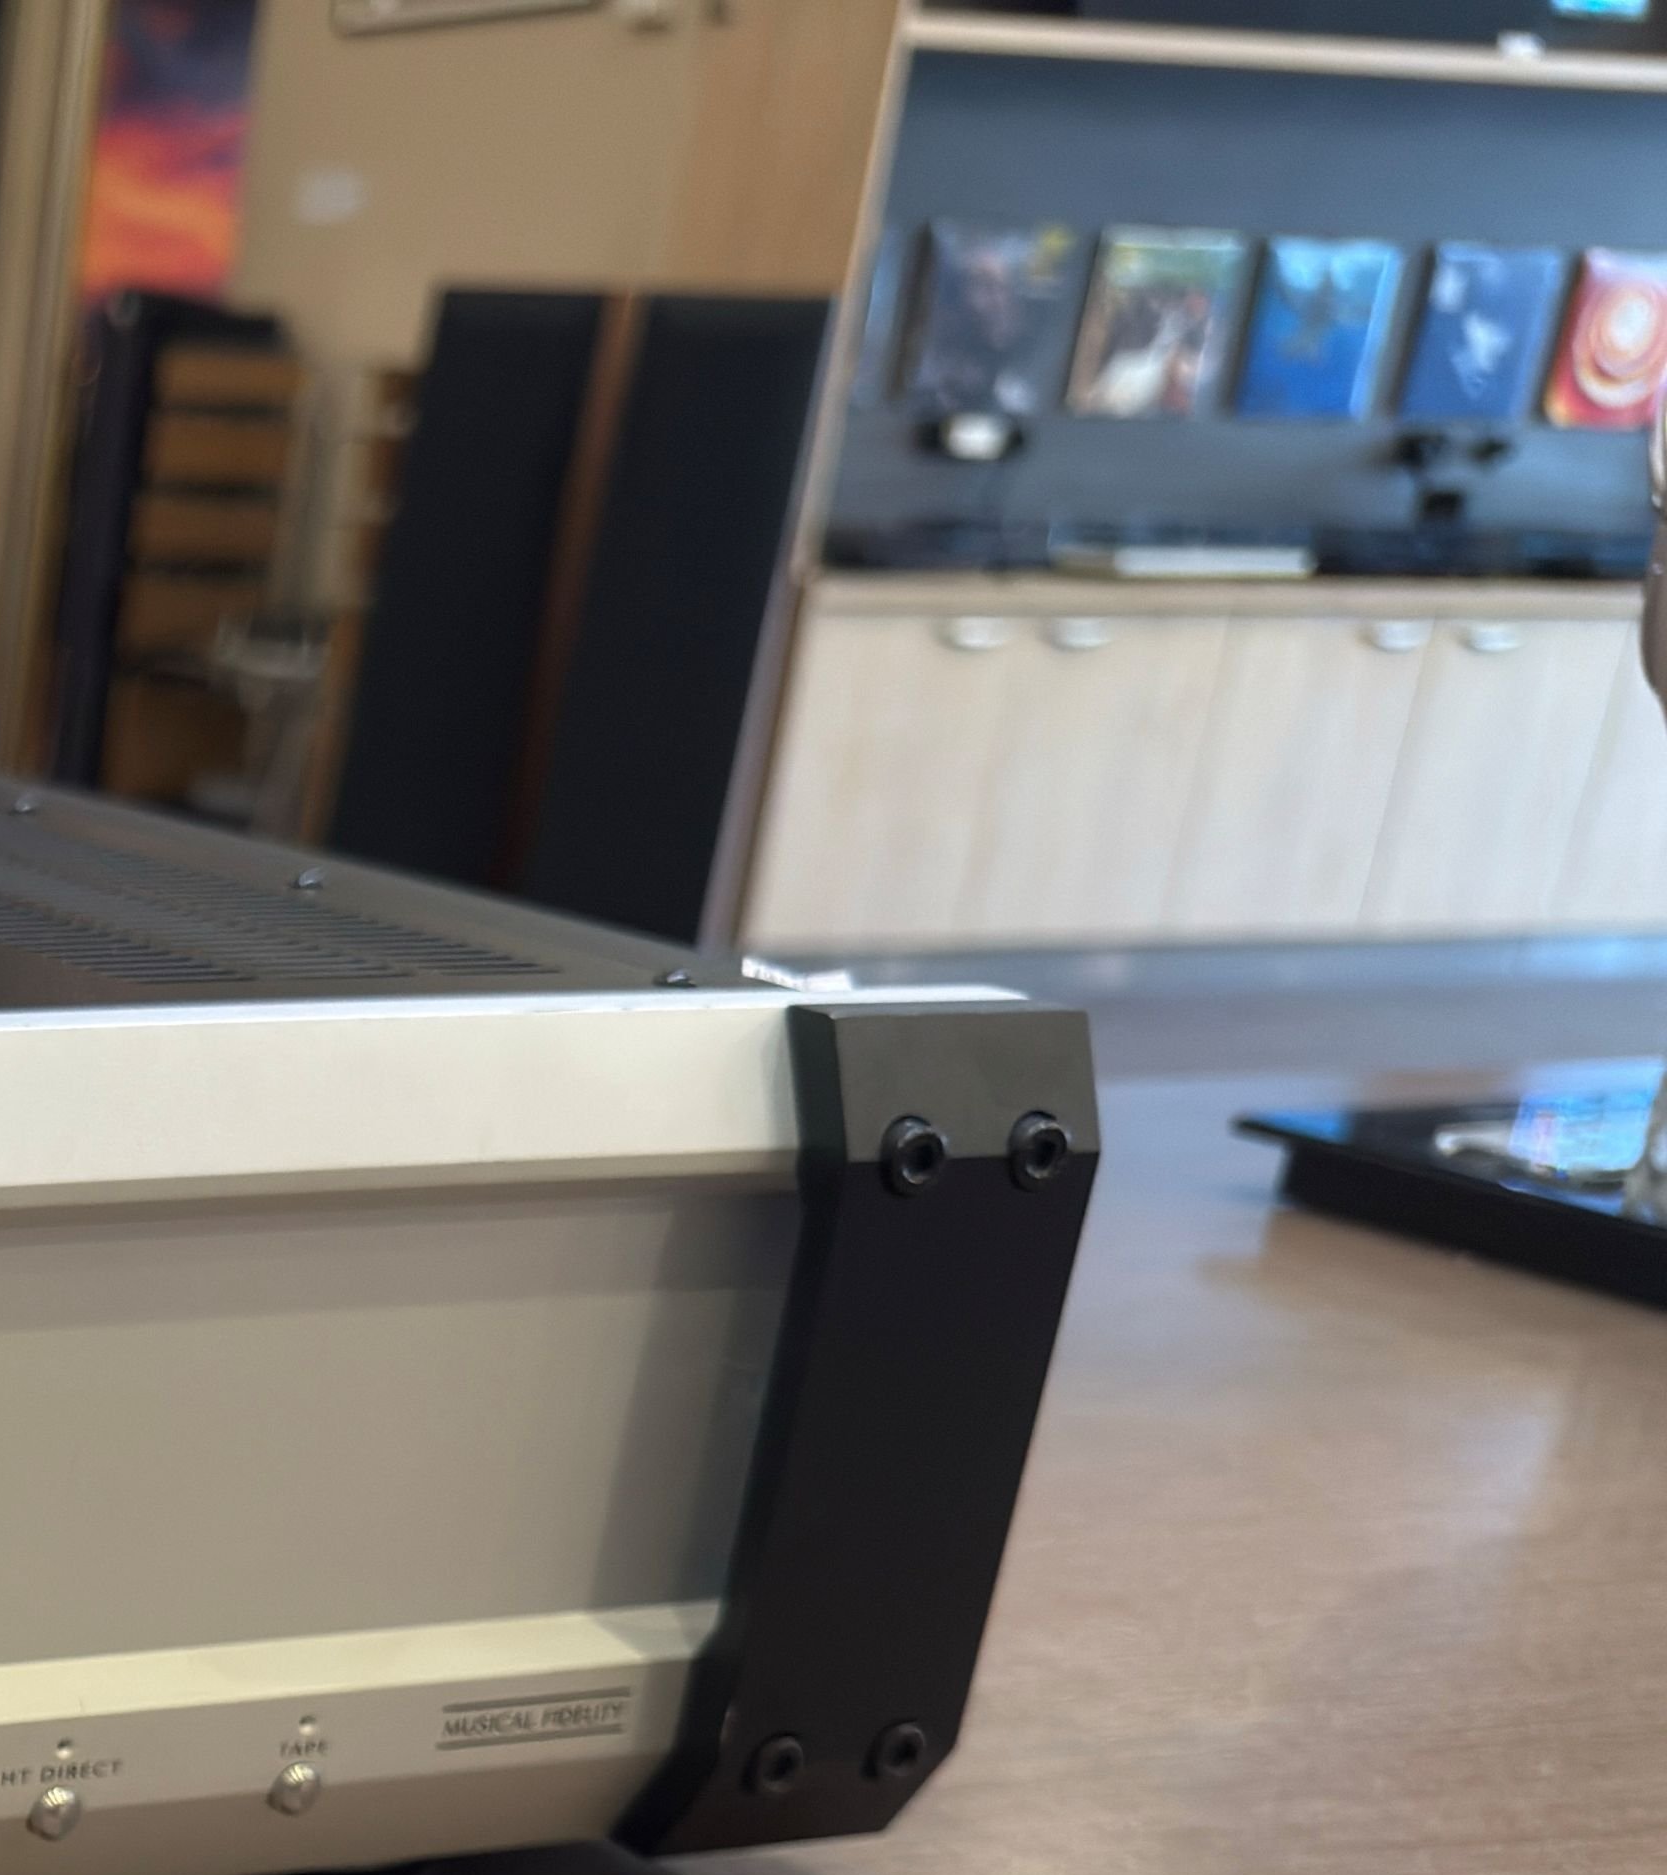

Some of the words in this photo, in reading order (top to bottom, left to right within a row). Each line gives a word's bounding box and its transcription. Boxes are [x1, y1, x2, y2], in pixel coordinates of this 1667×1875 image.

[441, 1707, 537, 1737] MUSICAL
[542, 1702, 625, 1730] FIDELITY
[279, 1738, 331, 1759] TAPE
[0, 1767, 32, 1786] HT
[40, 1759, 123, 1782] DIRECT
